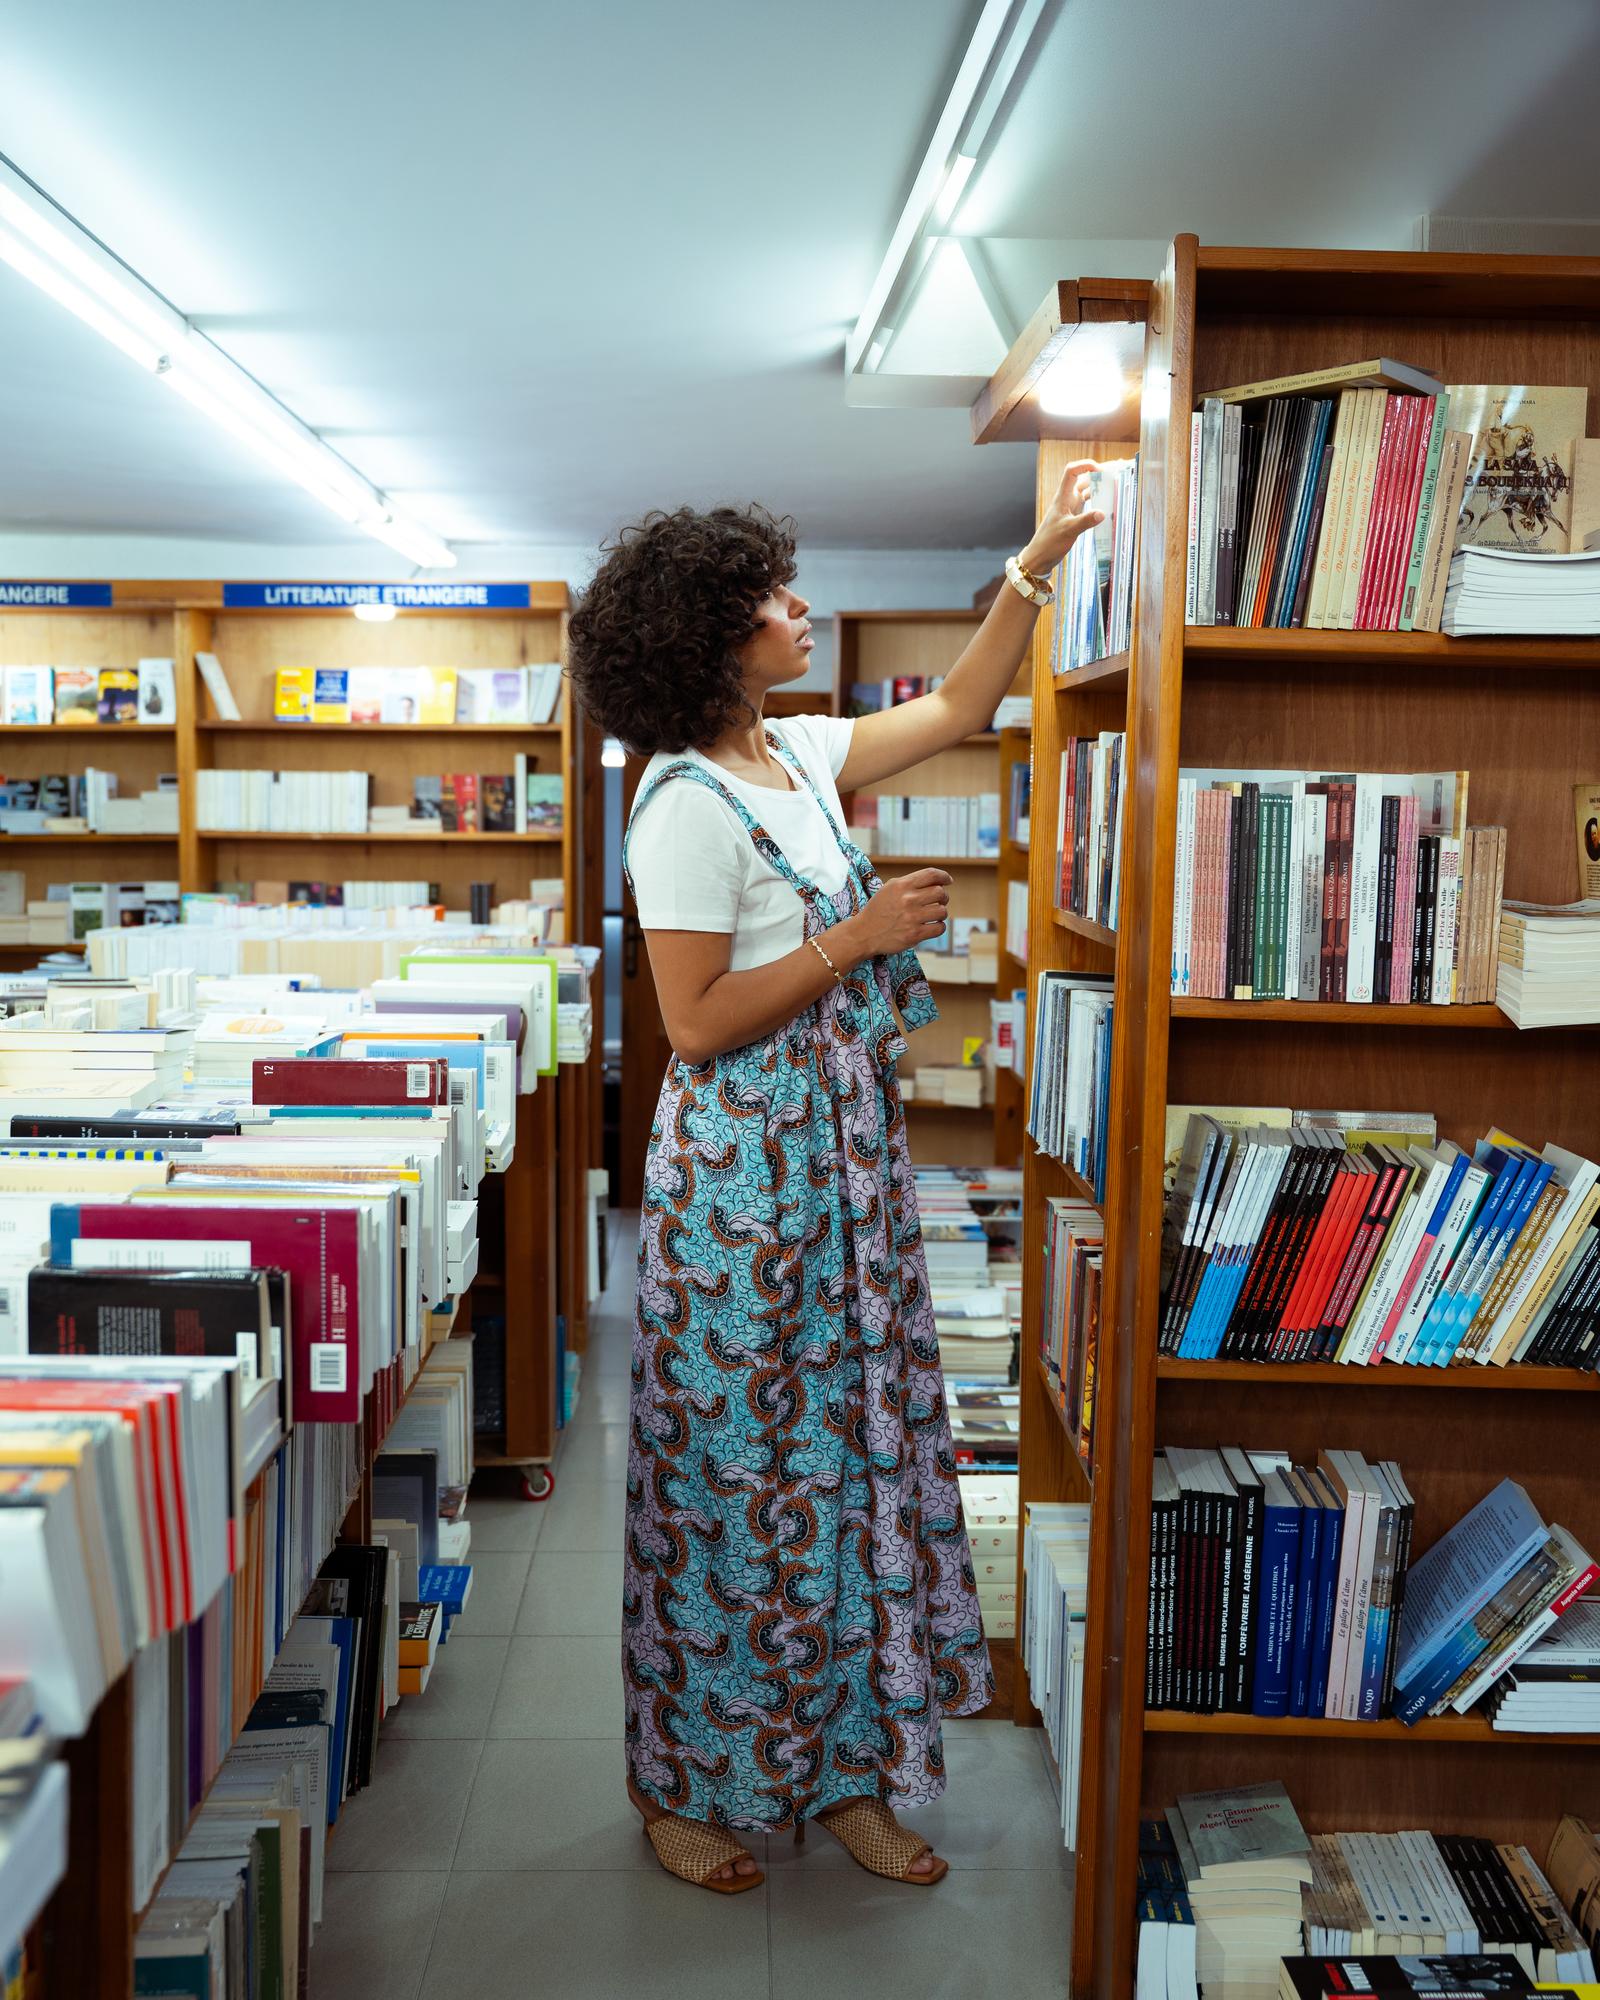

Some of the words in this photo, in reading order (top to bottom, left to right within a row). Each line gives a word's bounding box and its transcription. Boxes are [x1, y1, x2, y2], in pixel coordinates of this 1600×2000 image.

[1484, 459, 1501, 471] LA
[1413, 521, 1427, 559] Tentation
[1421, 482, 1433, 510] Double
[1427, 468, 1436, 481] Jeu
[265, 586, 380, 604] LITTERATURE
[383, 586, 488, 605] ETRANGERE
[1327, 861, 1335, 894] AL-ZANATI
[263, 1065, 274, 1076] 12
[1370, 1288, 1379, 1297] LA
[1378, 1286, 1391, 1306] tunnel
[1411, 1279, 1429, 1308] Mouvement
[1504, 1294, 1518, 1313] SANG
[1408, 1307, 1416, 1315] Le
[1222, 1547, 1231, 1584] D'ALGÉRIE
[1242, 1535, 1253, 1591] ALGÉRIENNE
[1271, 1565, 1279, 1600] QUOTIDIEN
[1286, 1583, 1294, 1608] Certeau
[1341, 1596, 1349, 1604] de
[1358, 1598, 1365, 1606] de
[1559, 1587, 1579, 1607] Auguste
[1221, 1587, 1229, 1631] POPULAIRES
[1269, 1611, 1276, 1619] ET
[1285, 1610, 1292, 1619] de
[1238, 1593, 1249, 1655] L'ORFÈVRERIE
[1219, 1633, 1227, 1665] ÉNIGMES
[1266, 1620, 1275, 1661] L'ORDINAIRE
[1489, 1649, 1517, 1678] Massinissa
[1363, 1688, 1374, 1713] NAQD
[1405, 1694, 1427, 1717] NAQD
